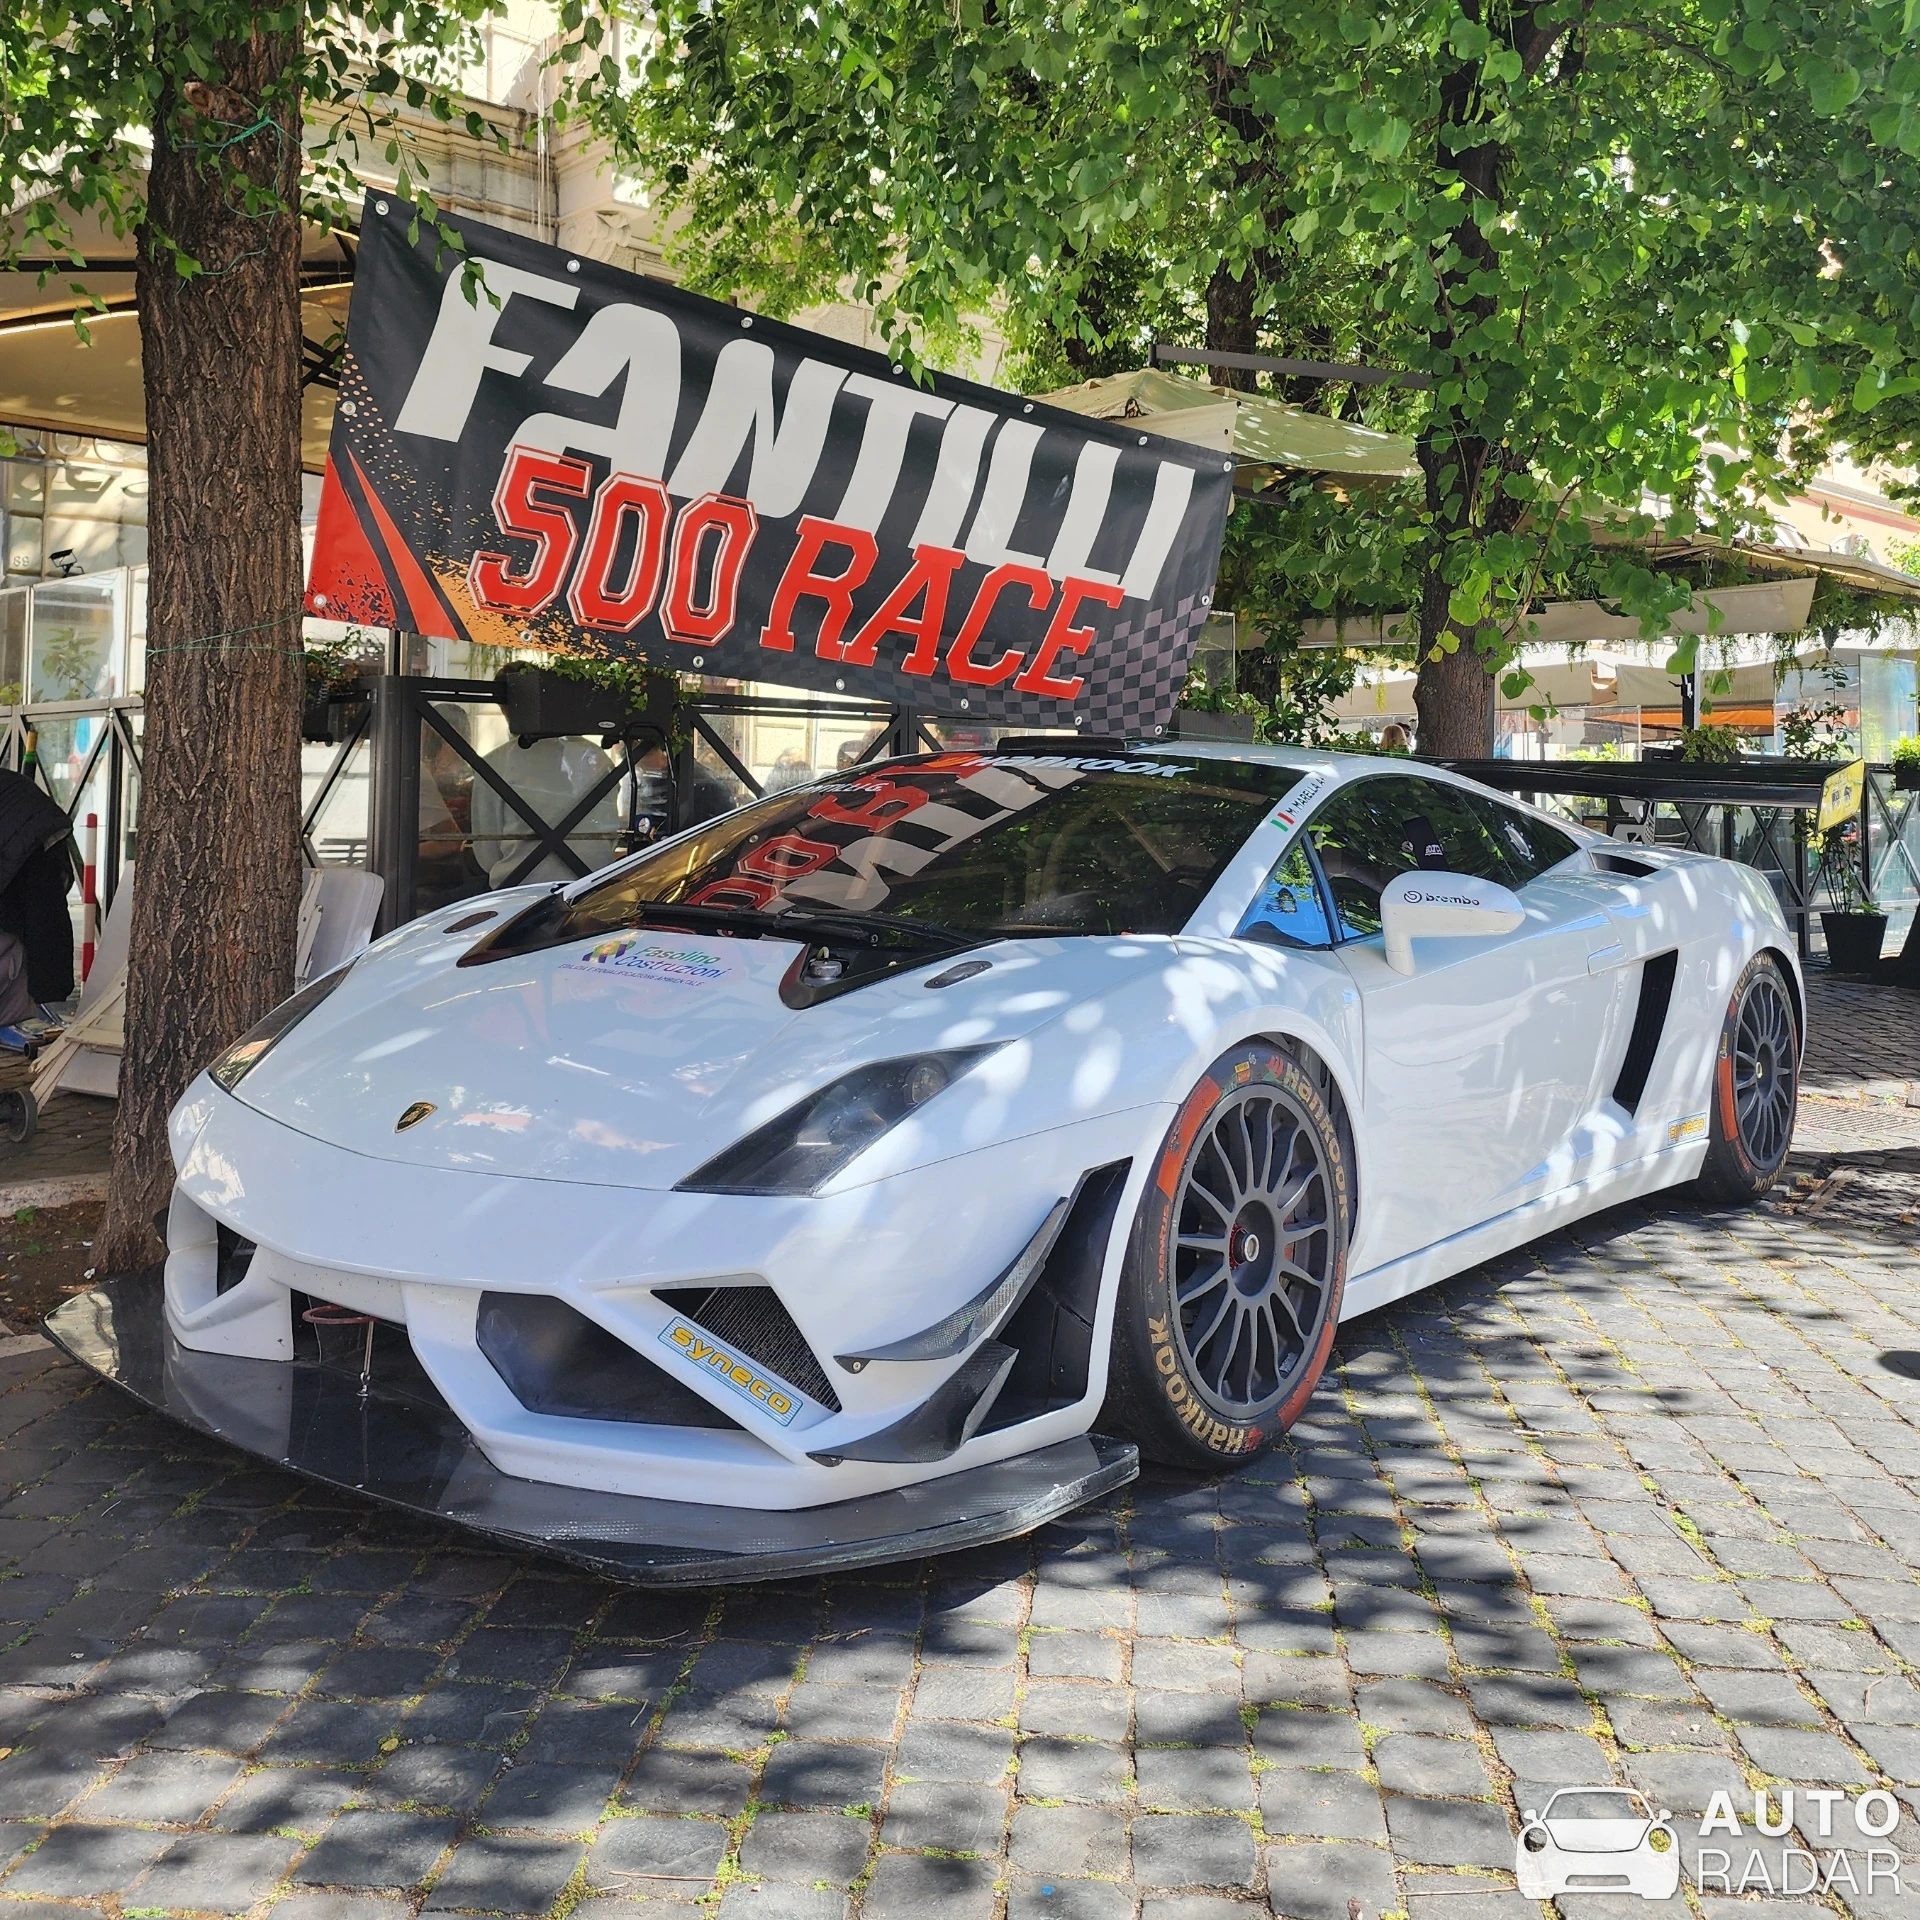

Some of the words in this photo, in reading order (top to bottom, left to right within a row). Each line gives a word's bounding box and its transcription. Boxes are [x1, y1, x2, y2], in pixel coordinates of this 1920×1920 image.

[394, 256, 1196, 600] FANTILLI
[467, 444, 759, 647] 500
[759, 516, 1125, 700] RACE
[1292, 782, 1321, 810] MARELLA
[1425, 892, 1480, 906] brembo
[615, 955, 732, 978] Costruzioni
[635, 946, 721, 964] Fasolino
[669, 1326, 792, 1415] syneco
